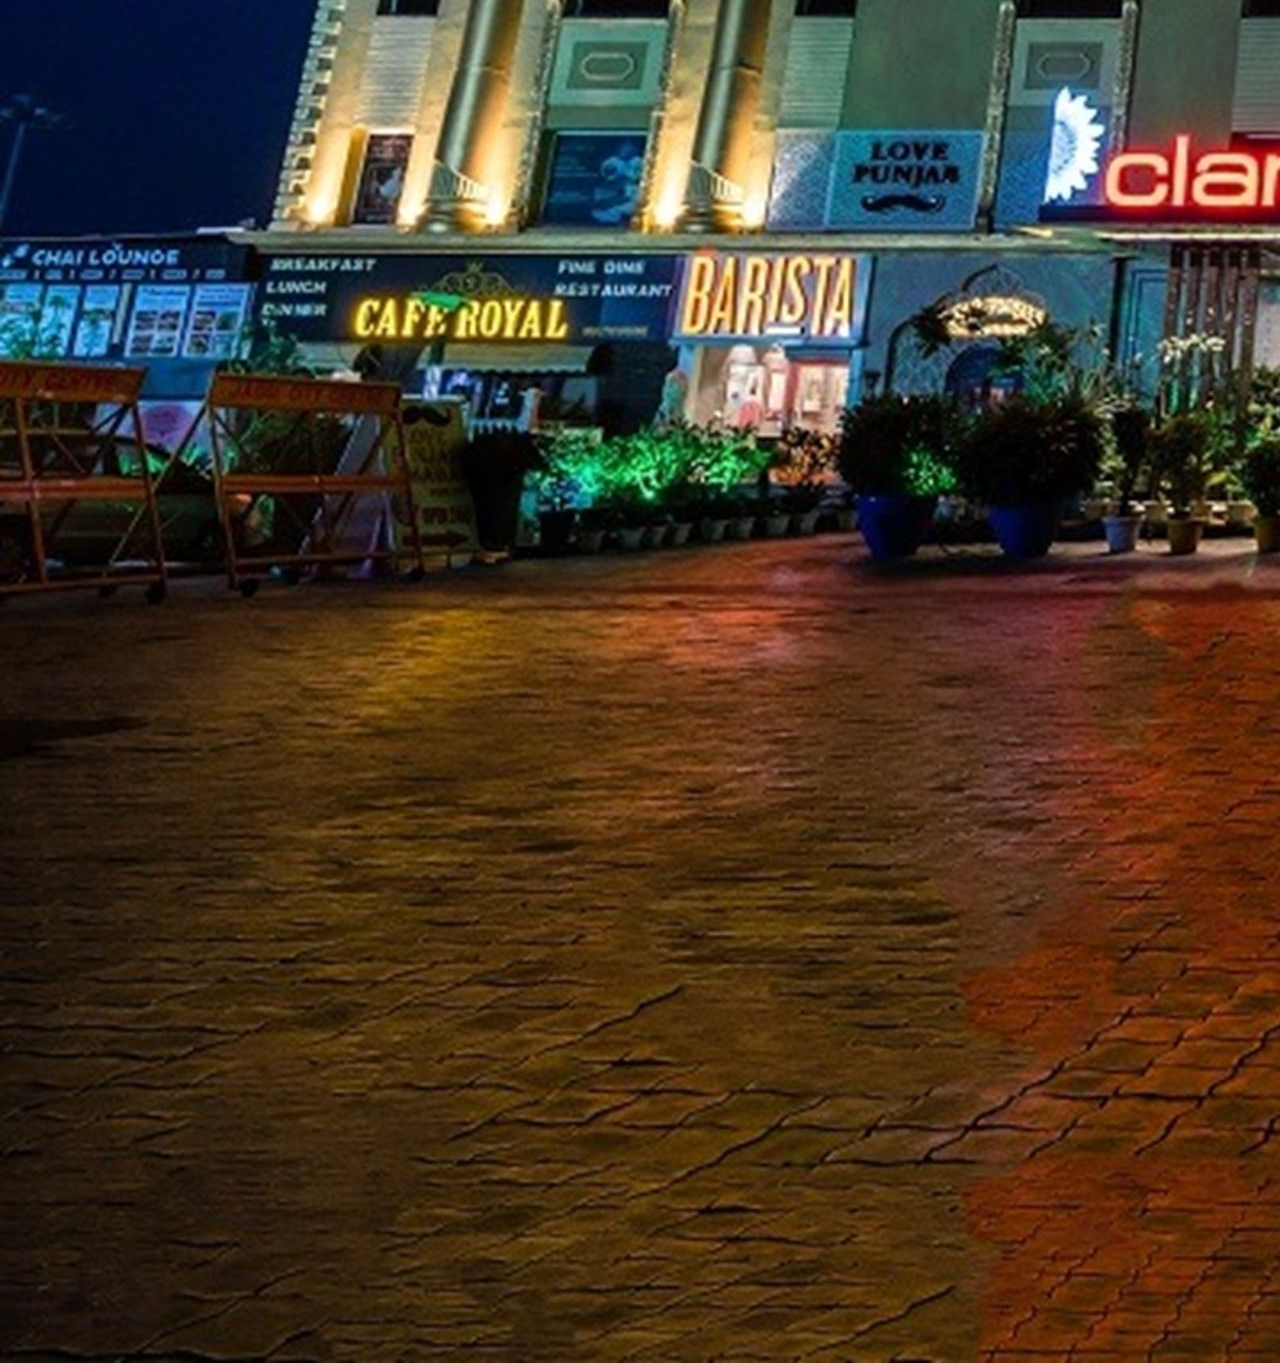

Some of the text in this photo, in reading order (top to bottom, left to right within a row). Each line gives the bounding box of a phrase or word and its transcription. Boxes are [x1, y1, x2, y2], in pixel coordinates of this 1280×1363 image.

[870, 140, 950, 161] LOVE
[853, 163, 960, 190] PUNJAB
[31, 248, 84, 266] CHAI
[269, 257, 377, 272] BREAKFAST
[556, 259, 597, 275] FINE
[265, 280, 327, 294] LUNCH
[552, 282, 674, 298] RESTAURANT
[682, 254, 855, 338] BARISTA
[354, 297, 569, 339] CAFE ROYAL
